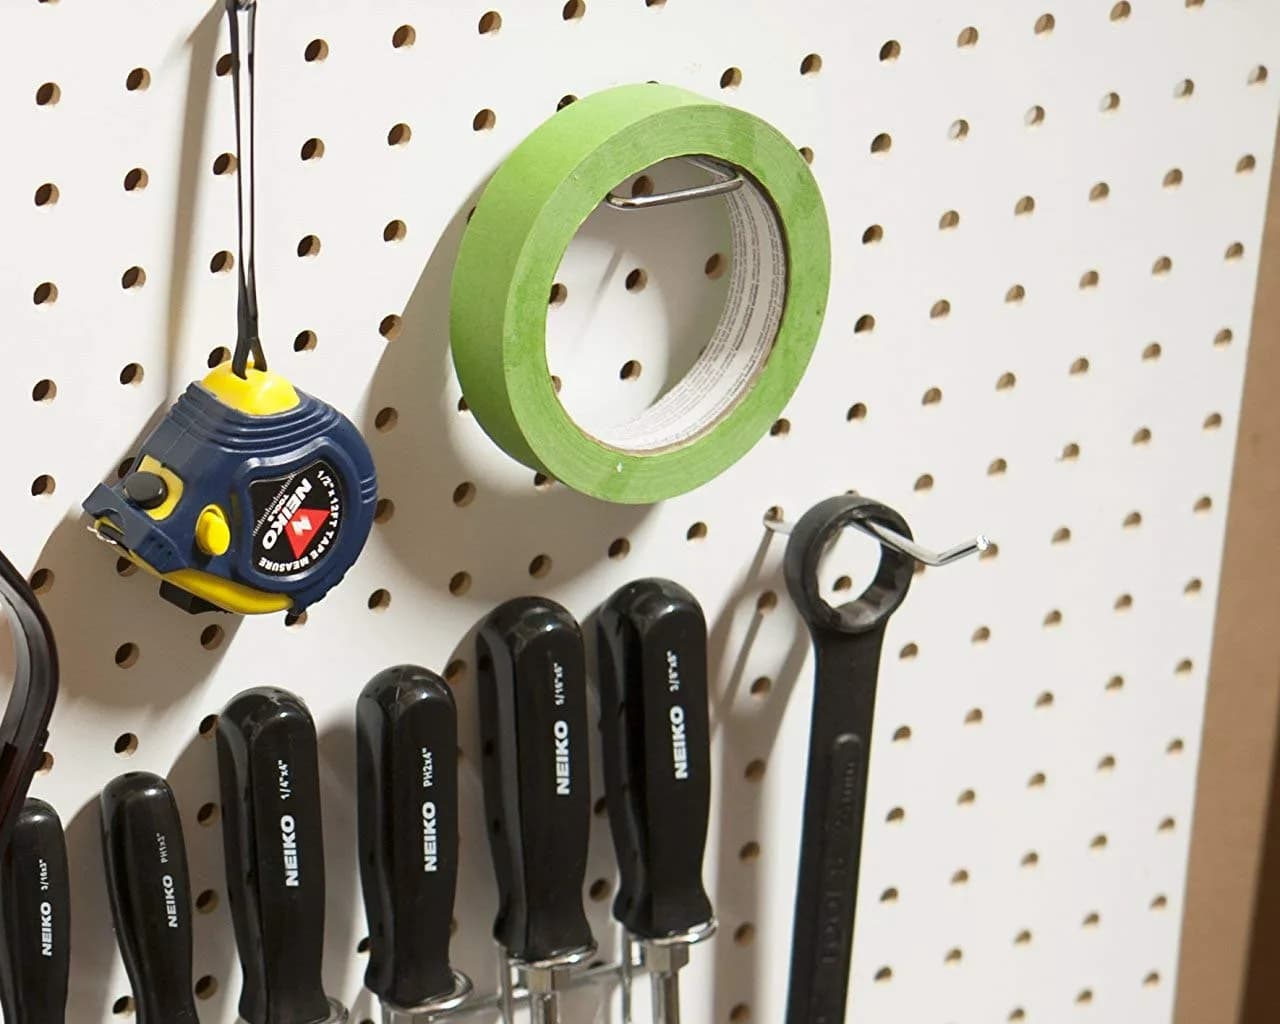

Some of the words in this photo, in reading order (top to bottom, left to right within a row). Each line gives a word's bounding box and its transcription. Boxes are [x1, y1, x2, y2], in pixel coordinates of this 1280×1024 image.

[262, 478, 313, 550] NEIKO
[268, 494, 290, 522] TOOLS
[259, 557, 309, 572] MEASURE
[310, 531, 335, 559] TAPE
[554, 720, 570, 795] NEIKO
[670, 706, 688, 779] NEIKO
[281, 815, 299, 886] NEIKO
[422, 801, 438, 872] NEIKO
[40, 902, 53, 956] NEIKO
[162, 875, 178, 928] NEIKO
